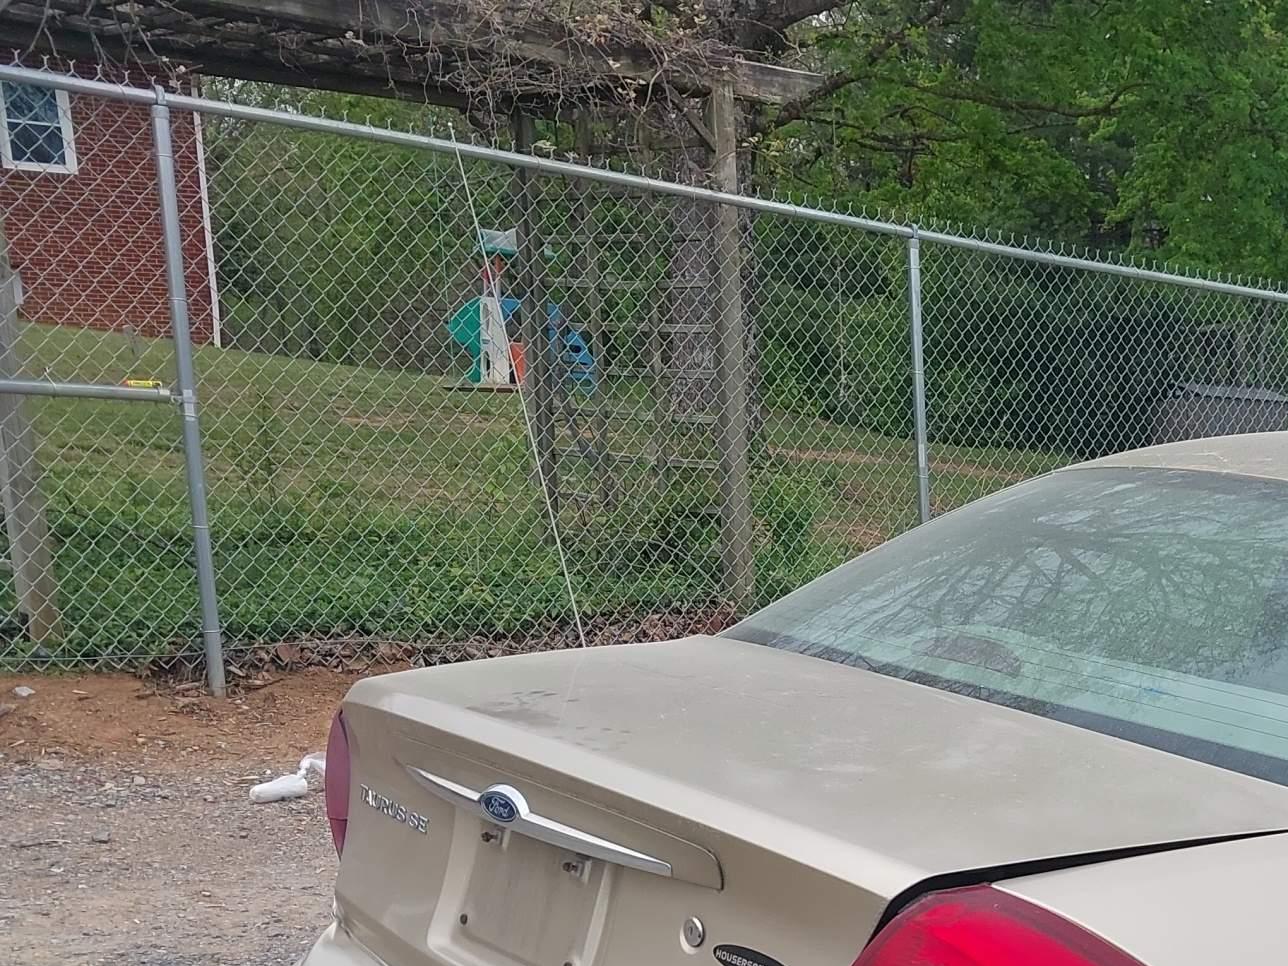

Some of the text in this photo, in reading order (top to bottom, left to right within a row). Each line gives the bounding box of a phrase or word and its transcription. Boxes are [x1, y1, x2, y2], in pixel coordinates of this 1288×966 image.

[360, 783, 429, 834] TAURUS SE
[488, 796, 512, 817] Ford
